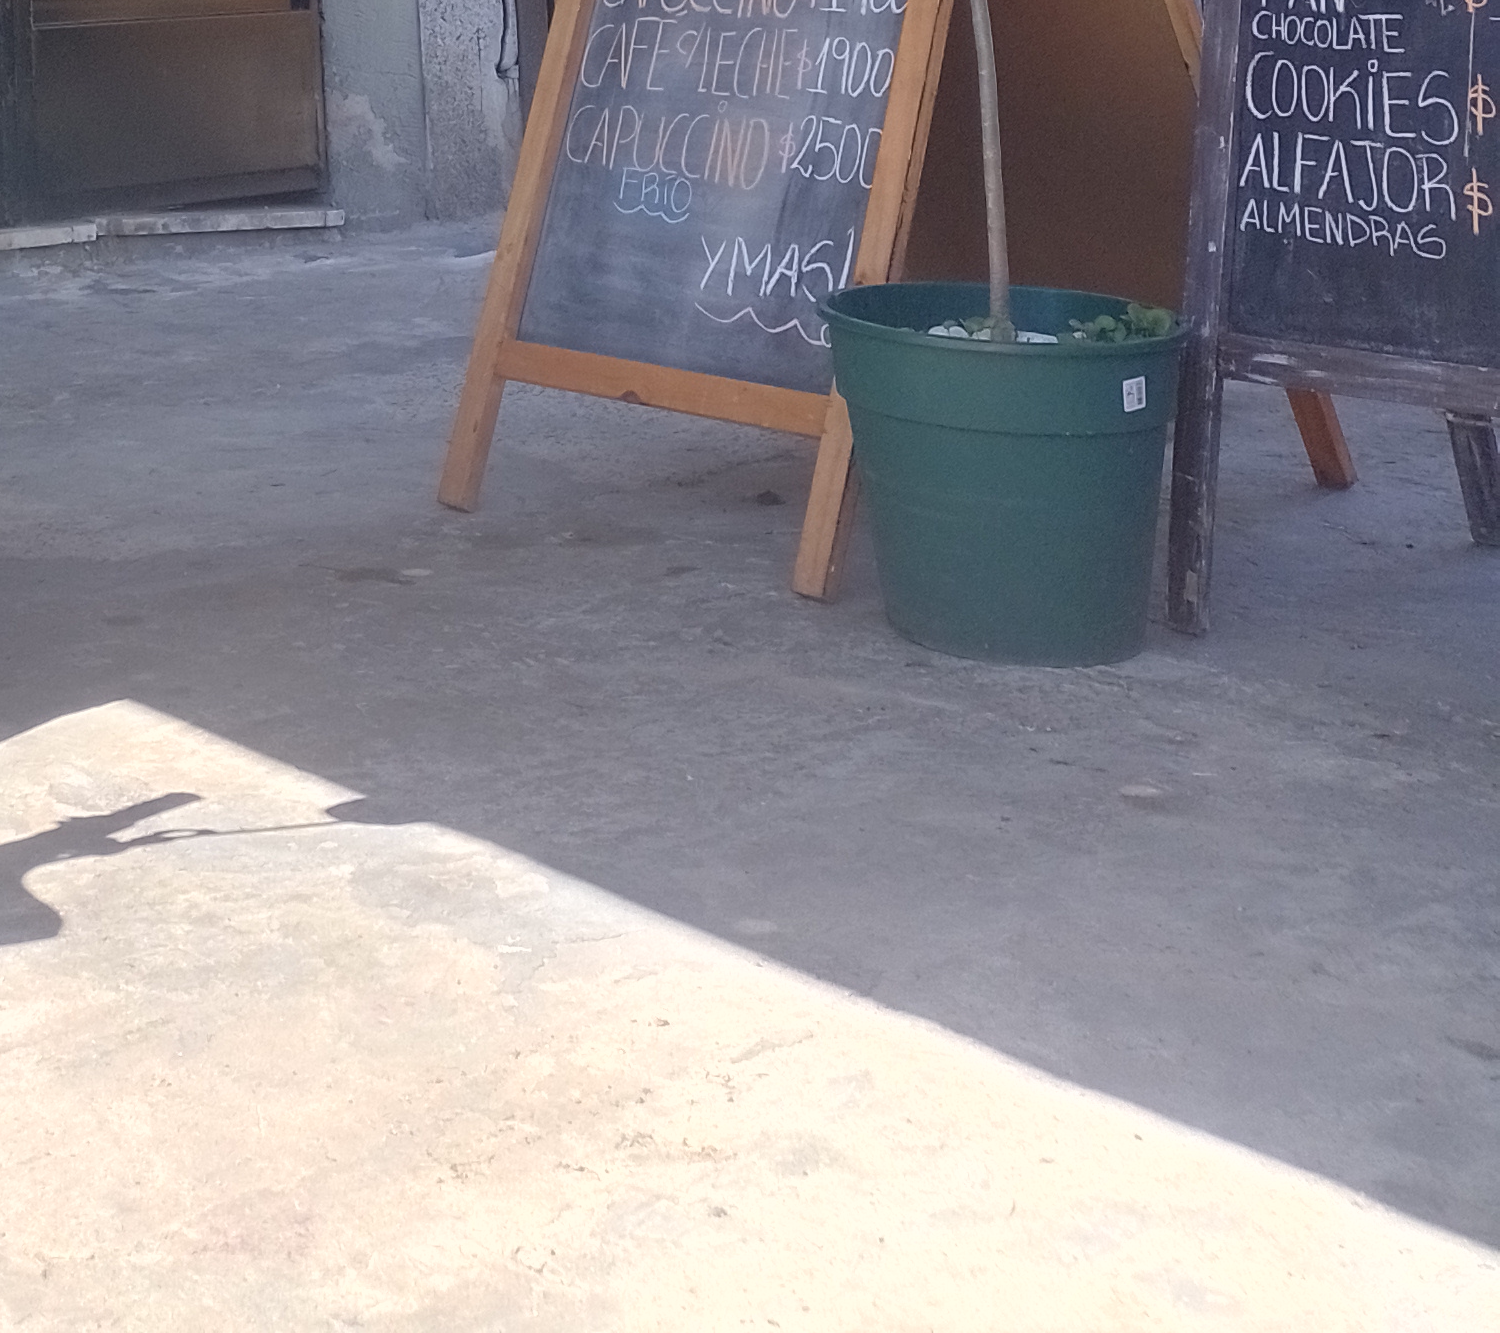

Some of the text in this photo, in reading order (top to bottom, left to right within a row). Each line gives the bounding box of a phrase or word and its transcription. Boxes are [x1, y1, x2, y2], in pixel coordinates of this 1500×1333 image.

[1251, 10, 1406, 54] CHOCOLATE
[1238, 131, 1458, 222] ALFAJOR
[1239, 197, 1447, 260] ALMENDRAS
